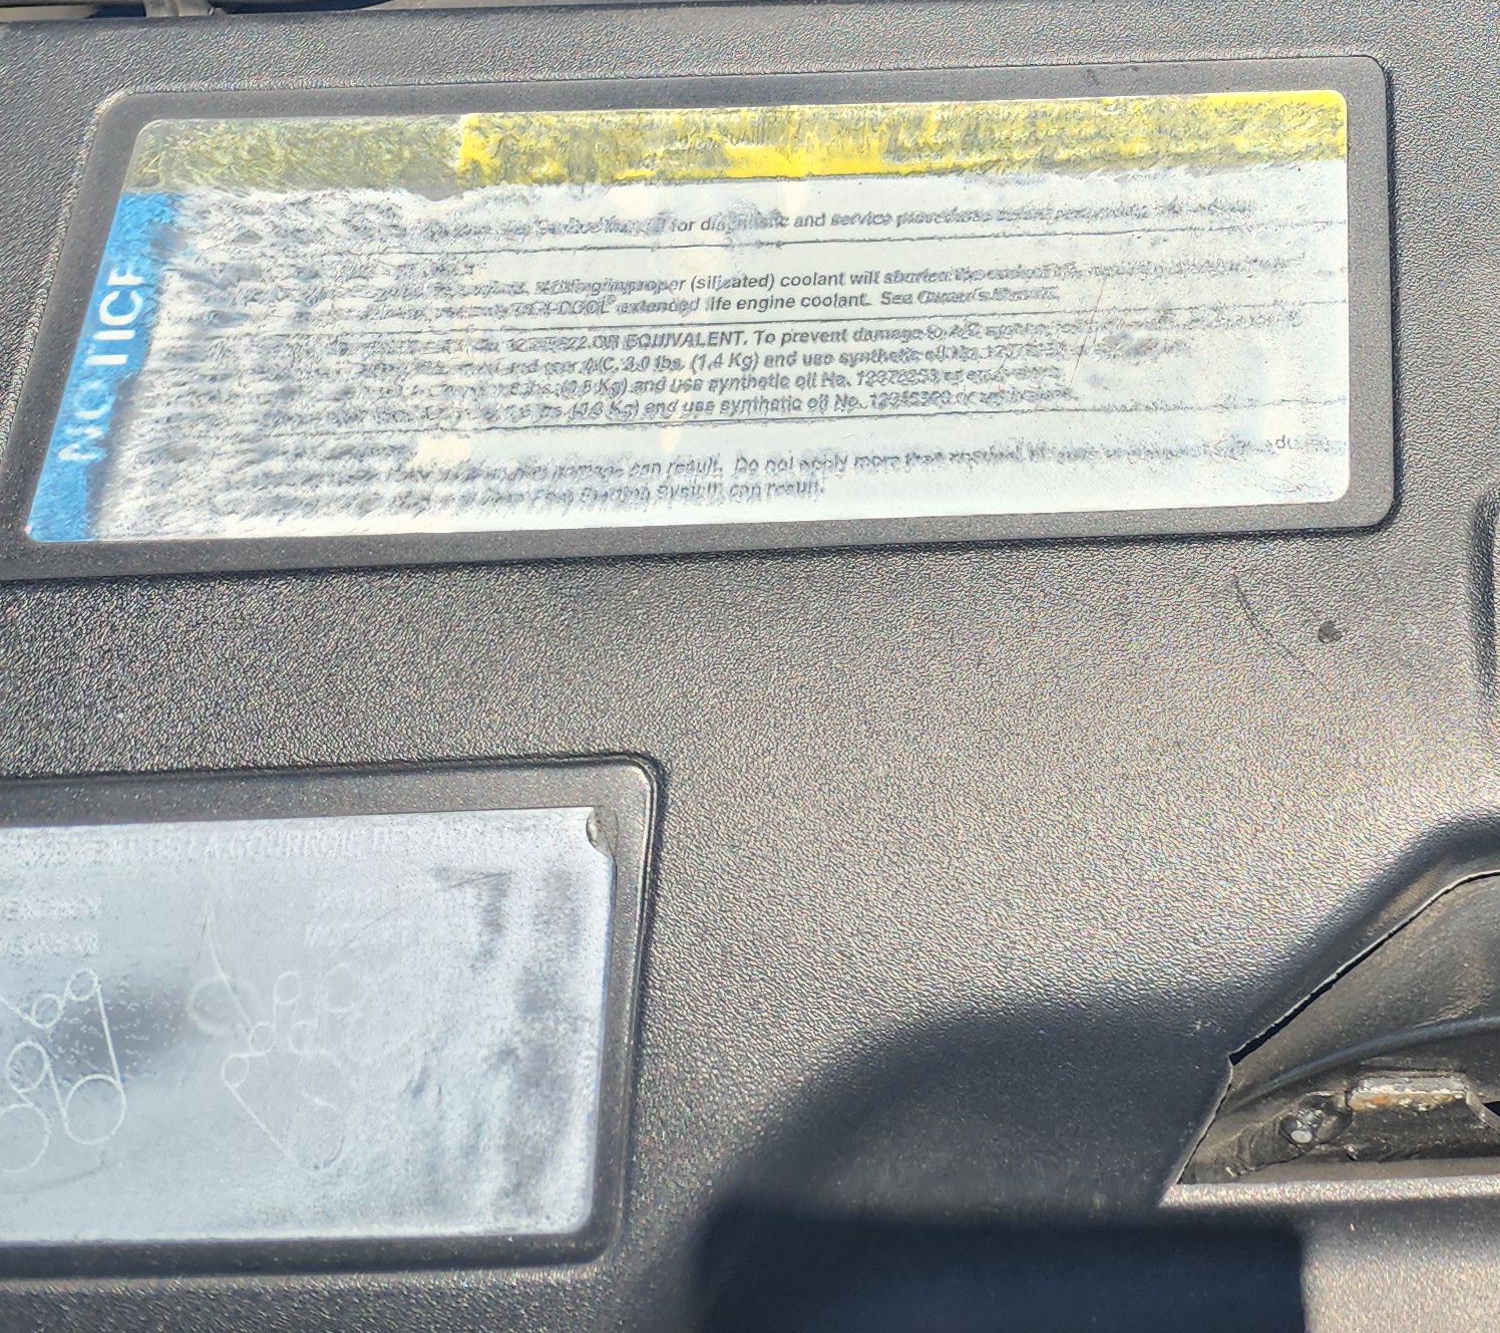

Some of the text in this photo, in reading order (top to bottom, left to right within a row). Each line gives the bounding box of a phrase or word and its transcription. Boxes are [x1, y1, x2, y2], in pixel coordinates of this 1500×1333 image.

[671, 217, 695, 233] for
[793, 212, 826, 228] and
[780, 270, 846, 288] coolant
[737, 293, 796, 313] engine
[881, 290, 913, 306] See
[754, 330, 776, 345] To
[781, 327, 849, 347] prevent
[763, 350, 798, 368] and
